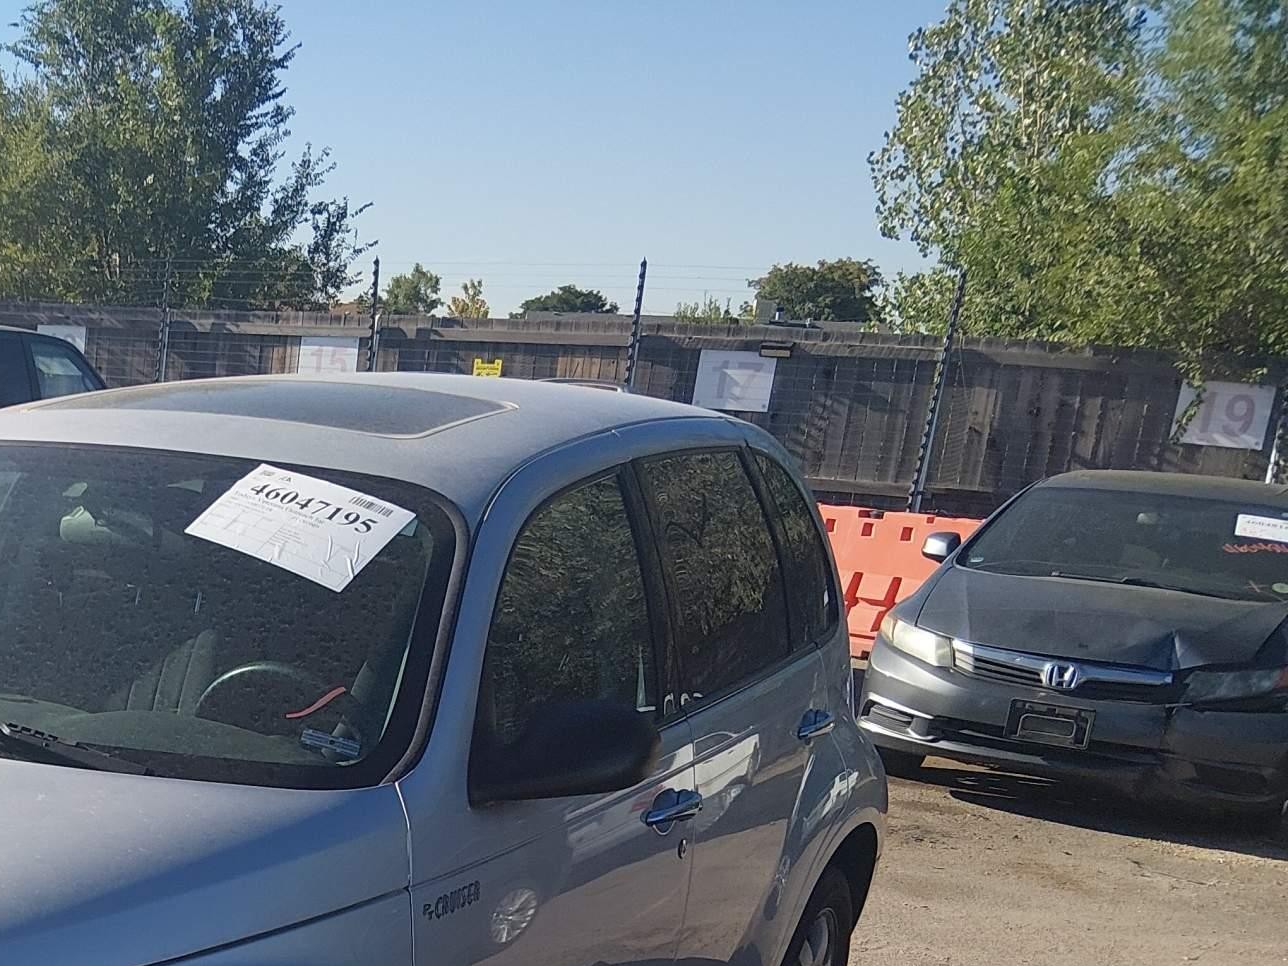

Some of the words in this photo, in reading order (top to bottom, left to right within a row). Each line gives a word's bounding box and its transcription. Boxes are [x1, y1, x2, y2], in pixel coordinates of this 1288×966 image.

[1199, 391, 1256, 438] 19
[250, 483, 380, 534] 46047195
[434, 880, 481, 919] CRUISER
